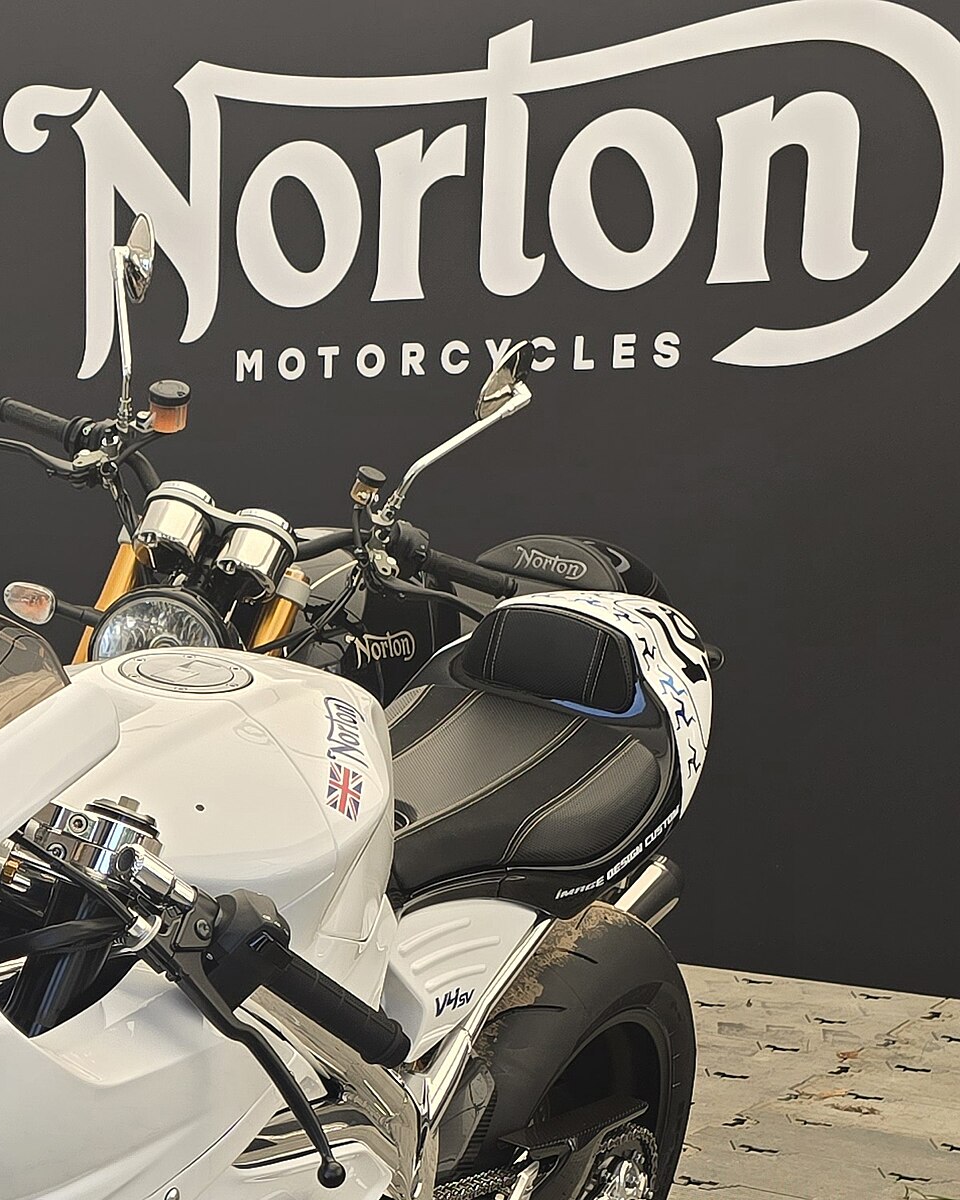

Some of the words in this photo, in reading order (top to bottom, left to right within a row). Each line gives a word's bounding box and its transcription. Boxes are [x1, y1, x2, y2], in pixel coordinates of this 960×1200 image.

[2, 0, 960, 380] Norton
[515, 546, 588, 580] Norton
[344, 630, 416, 669] Norton
[323, 695, 369, 769] Norton
